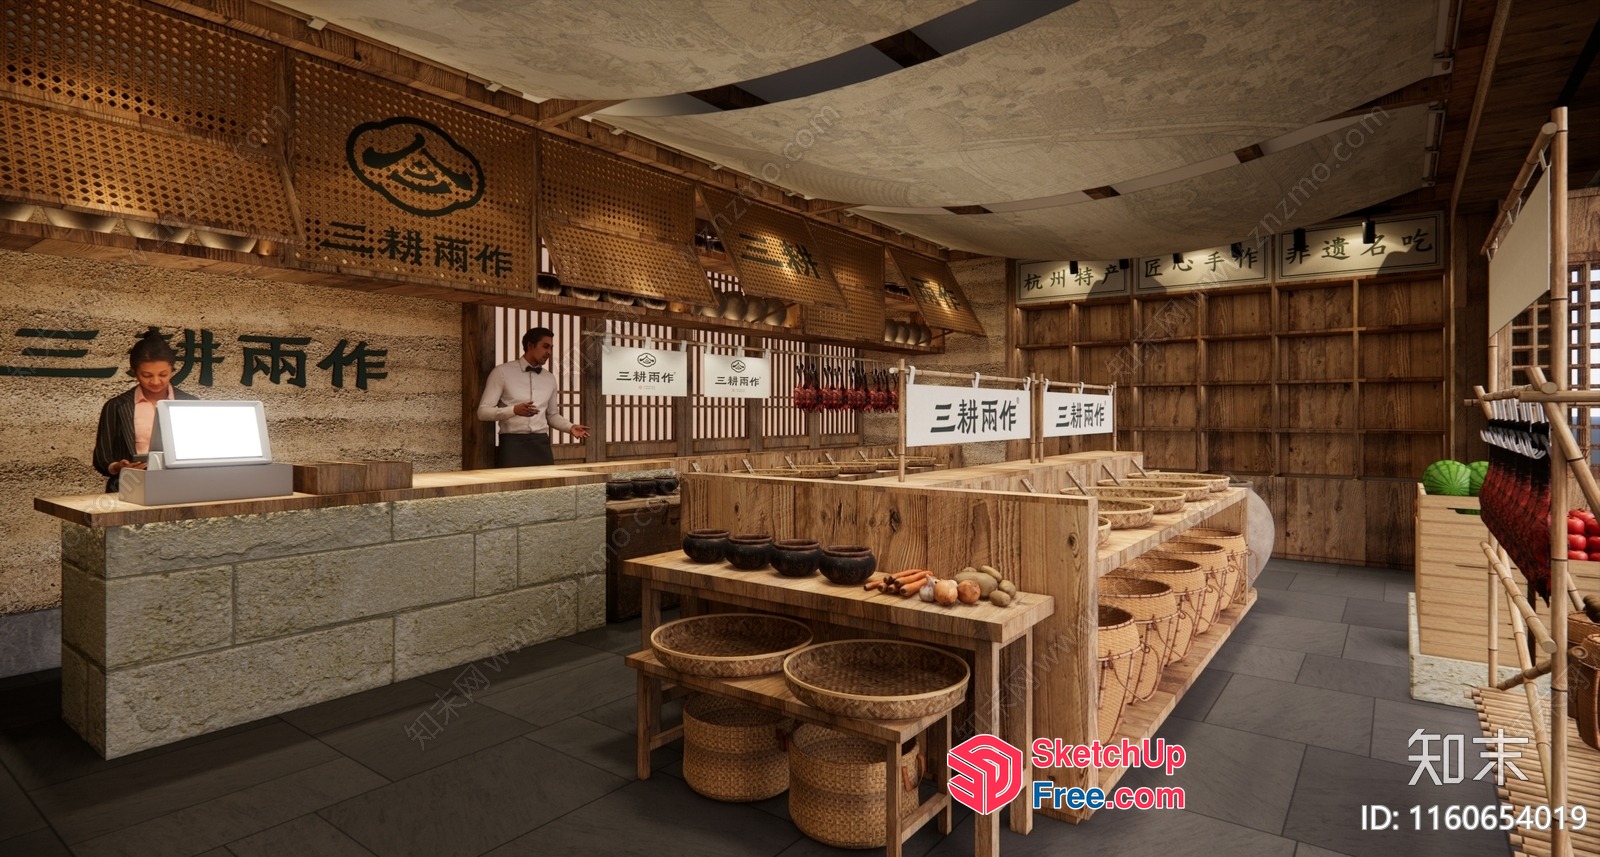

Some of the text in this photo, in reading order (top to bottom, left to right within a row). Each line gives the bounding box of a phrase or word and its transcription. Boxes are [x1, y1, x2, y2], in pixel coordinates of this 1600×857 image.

[739, 233, 821, 279] 三耕
[1145, 248, 1258, 278] 匠心手作
[1286, 228, 1433, 265] 非遗名吃
[1024, 264, 1119, 291] 杭州特产
